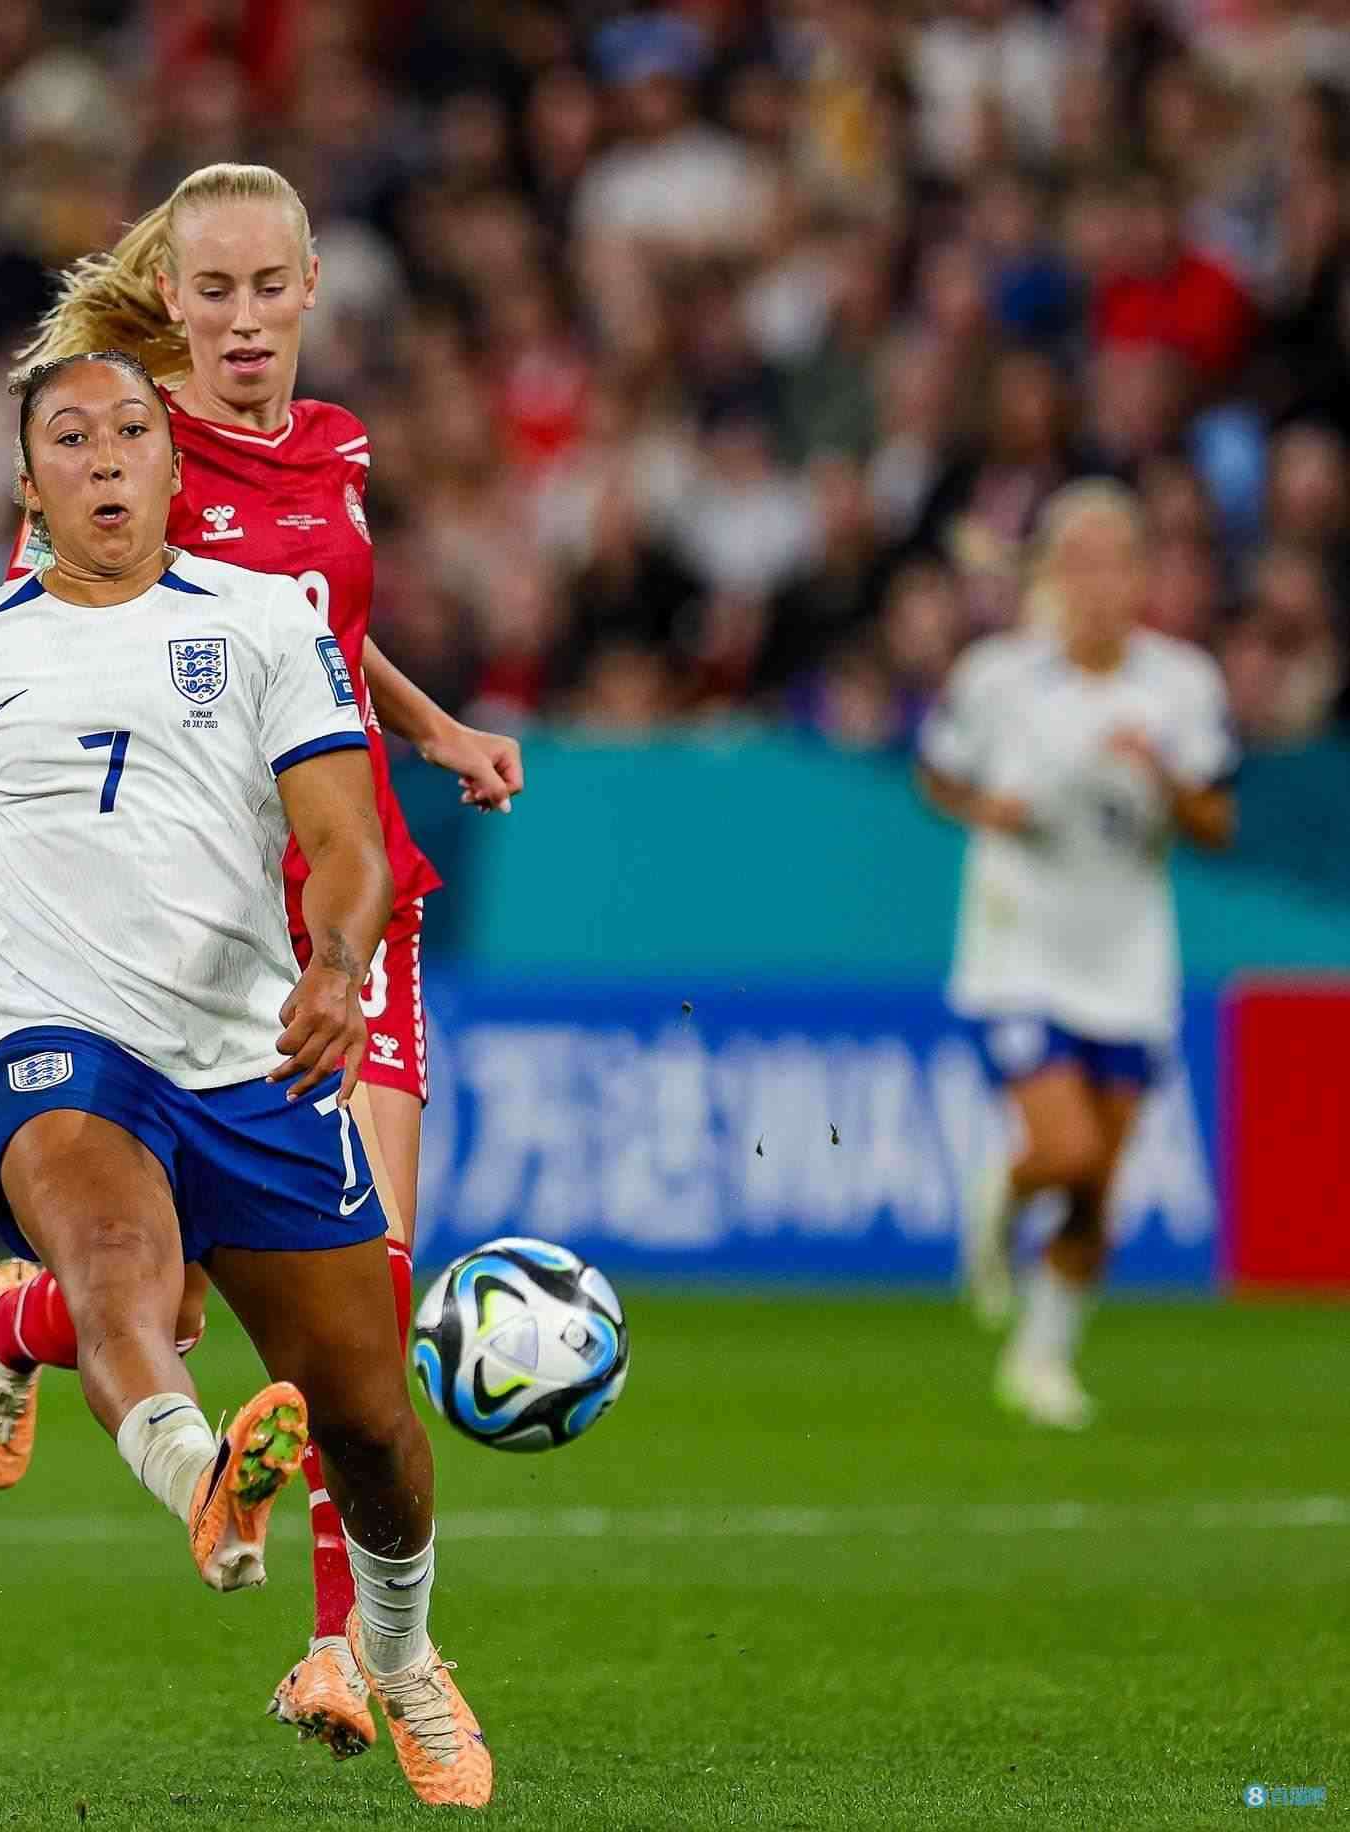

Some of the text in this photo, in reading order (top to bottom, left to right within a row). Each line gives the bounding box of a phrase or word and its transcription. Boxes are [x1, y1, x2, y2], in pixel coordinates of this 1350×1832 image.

[192, 719, 204, 728] JULY
[77, 730, 131, 814] 7
[314, 1090, 356, 1189] 7
